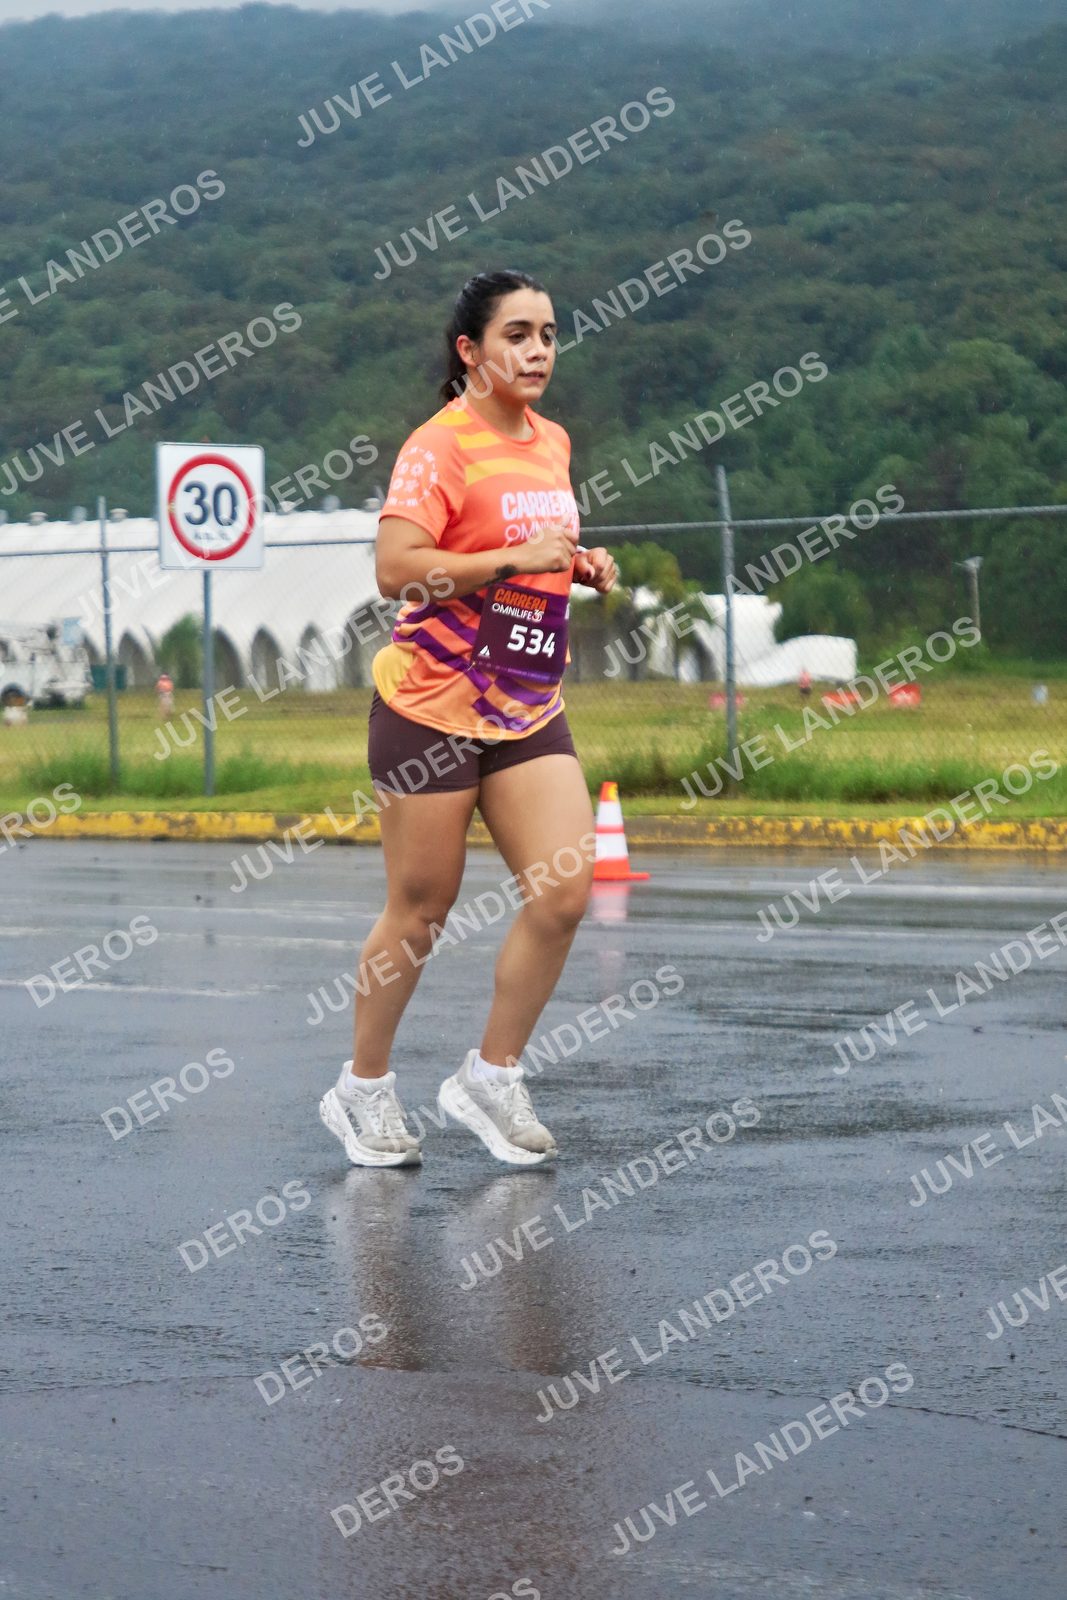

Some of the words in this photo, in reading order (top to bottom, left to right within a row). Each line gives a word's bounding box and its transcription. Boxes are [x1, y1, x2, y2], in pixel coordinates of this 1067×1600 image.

[183, 480, 239, 527] 30
[494, 588, 548, 611] CARRERA
[507, 624, 556, 658] 534
